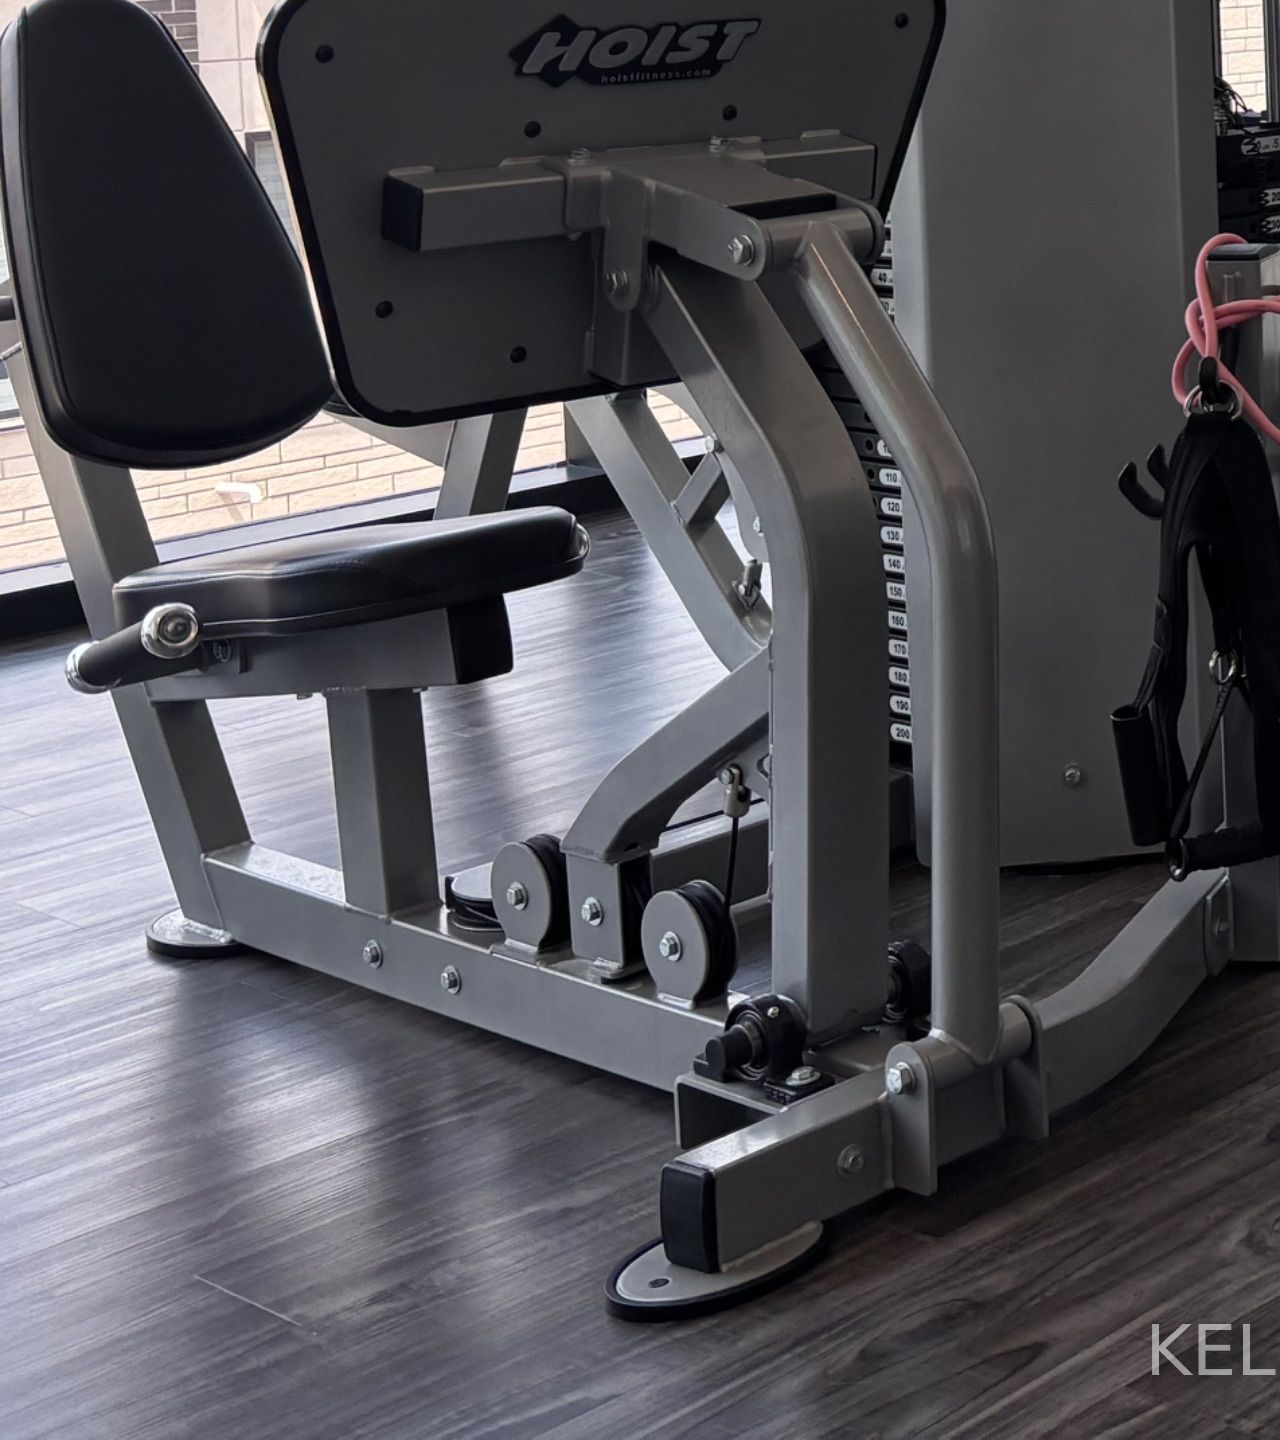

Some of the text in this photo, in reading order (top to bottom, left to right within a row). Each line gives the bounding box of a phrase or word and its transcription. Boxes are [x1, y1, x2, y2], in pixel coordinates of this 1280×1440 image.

[521, 20, 760, 74] HOIST
[601, 69, 712, 84] hoistfitness.com
[885, 472, 898, 483] 110
[886, 502, 900, 513] 120
[886, 530, 900, 541] 130
[888, 558, 902, 569] 140
[889, 585, 902, 597] 150
[891, 615, 904, 626] 160
[893, 643, 907, 655] 170
[894, 671, 907, 683] 180
[896, 700, 909, 711] 190
[896, 727, 910, 739] 200
